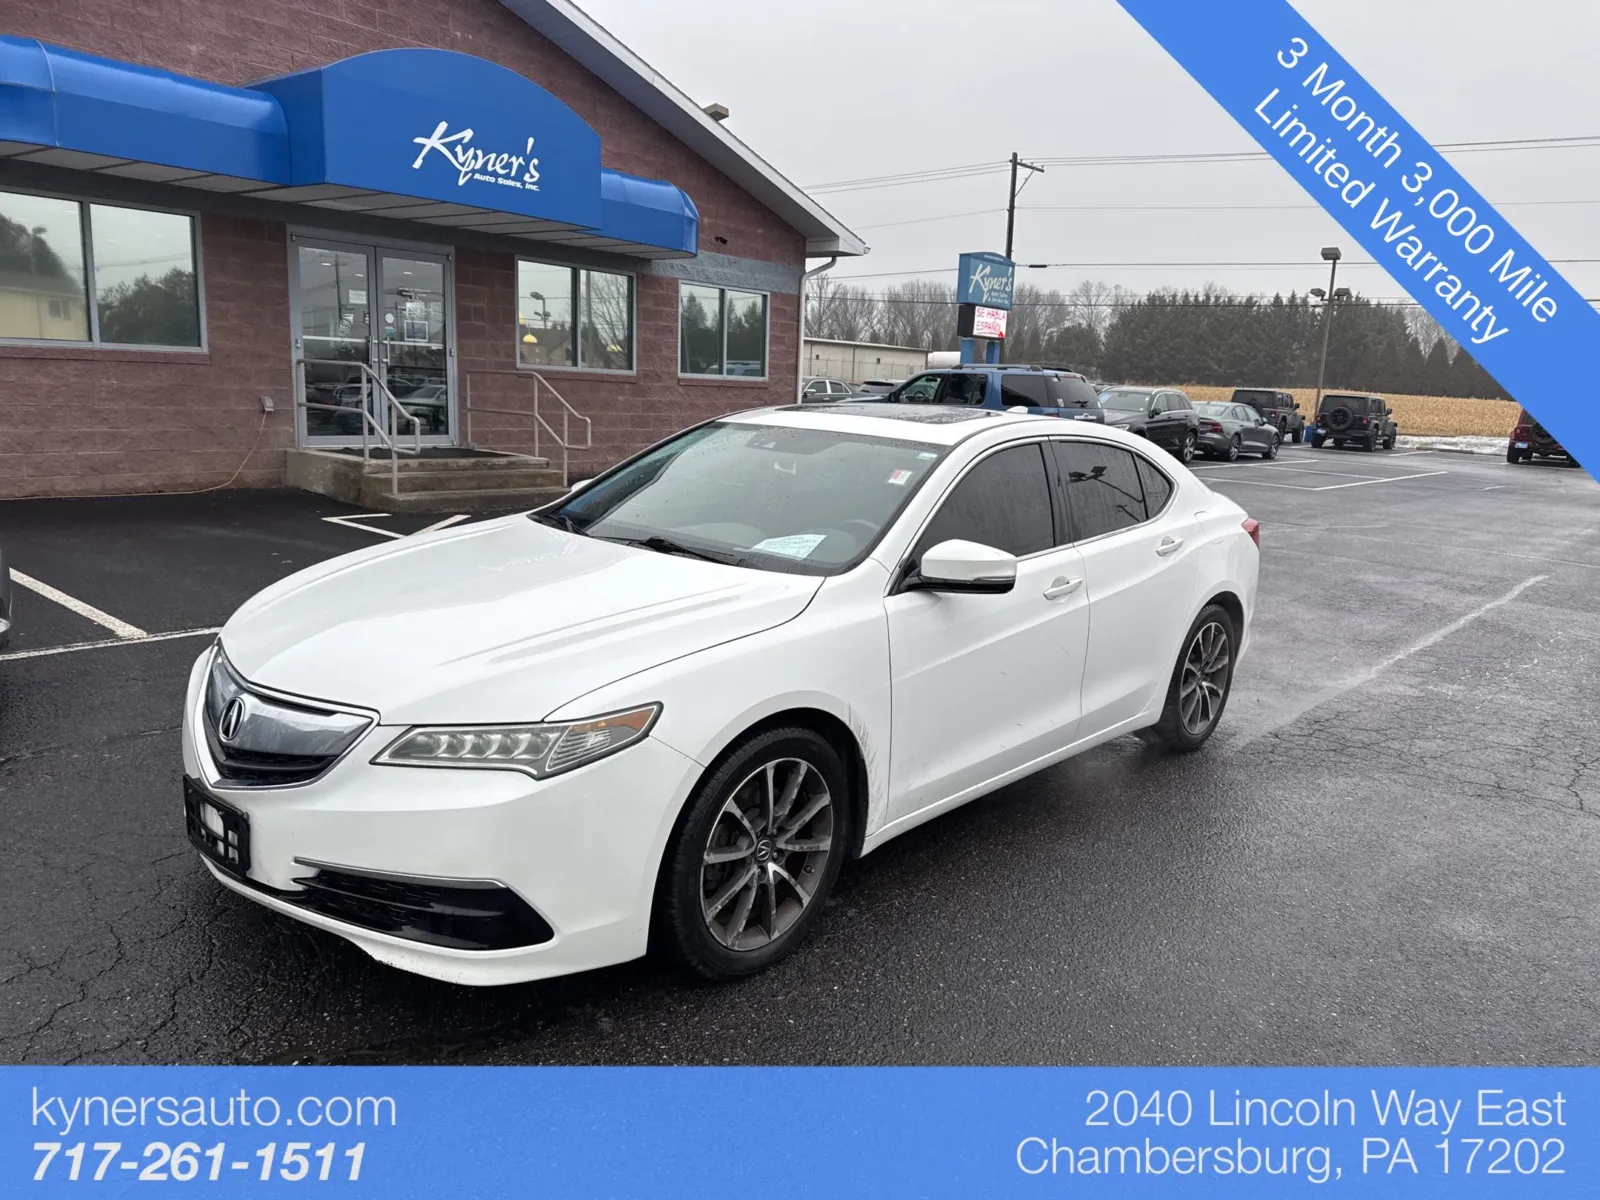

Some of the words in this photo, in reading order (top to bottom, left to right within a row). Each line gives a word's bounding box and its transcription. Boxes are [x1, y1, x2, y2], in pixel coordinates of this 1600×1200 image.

[411, 120, 541, 187] Kyner's
[473, 172, 496, 183] Auto
[497, 177, 523, 189] Sales,
[525, 182, 540, 191] Inc.
[969, 263, 1012, 303] Kyner's
